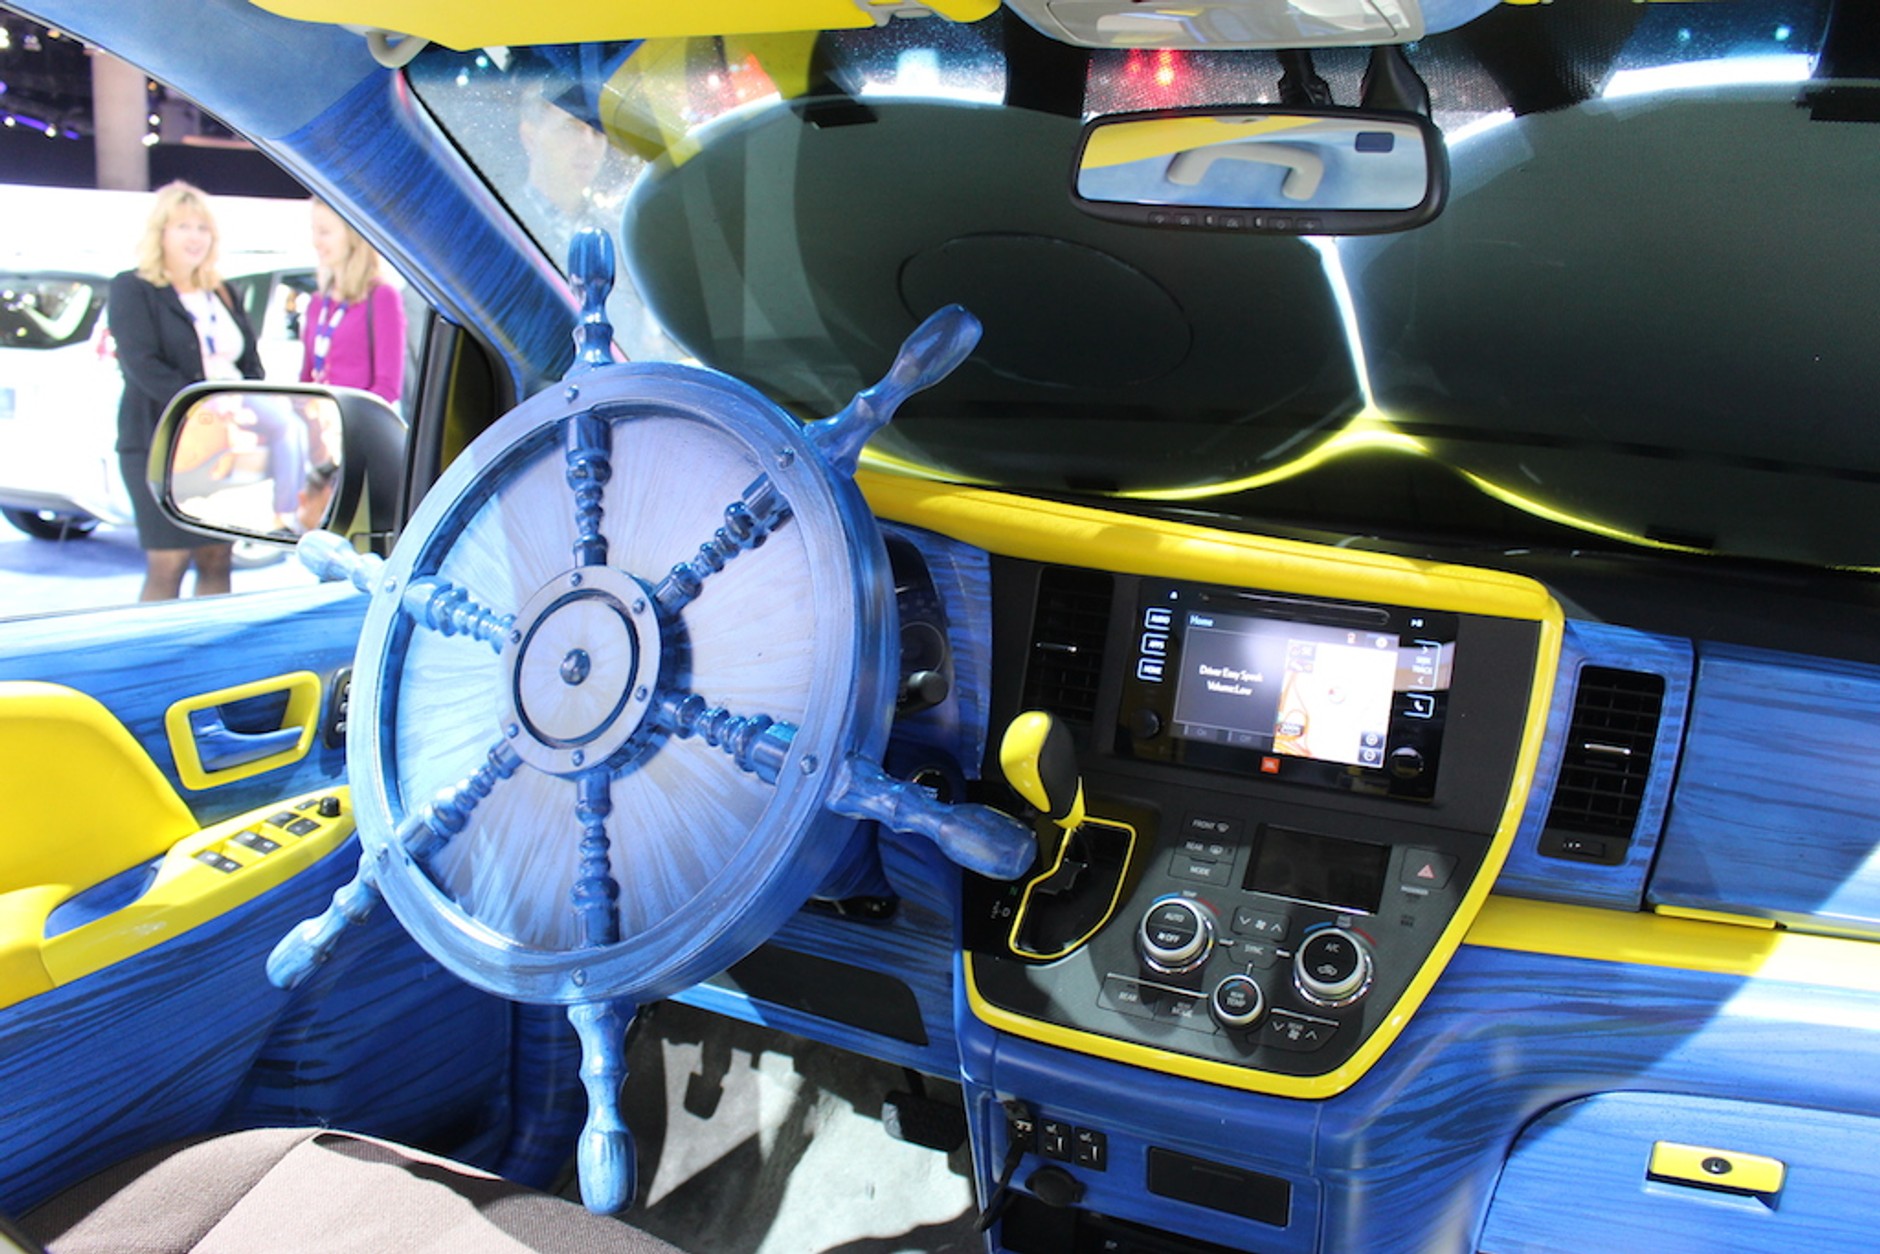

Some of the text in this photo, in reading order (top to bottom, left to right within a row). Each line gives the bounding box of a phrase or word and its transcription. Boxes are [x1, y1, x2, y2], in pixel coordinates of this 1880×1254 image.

[1189, 615, 1213, 627] Home
[1199, 664, 1222, 677] Driver
[1191, 819, 1215, 830] FRONT
[1185, 841, 1204, 851] REAR
[1164, 912, 1185, 923] AUTO
[1165, 933, 1180, 943] OFF
[1324, 943, 1340, 953] A/C
[1118, 991, 1138, 1003] REAR
[1227, 997, 1246, 1008] TEMP
